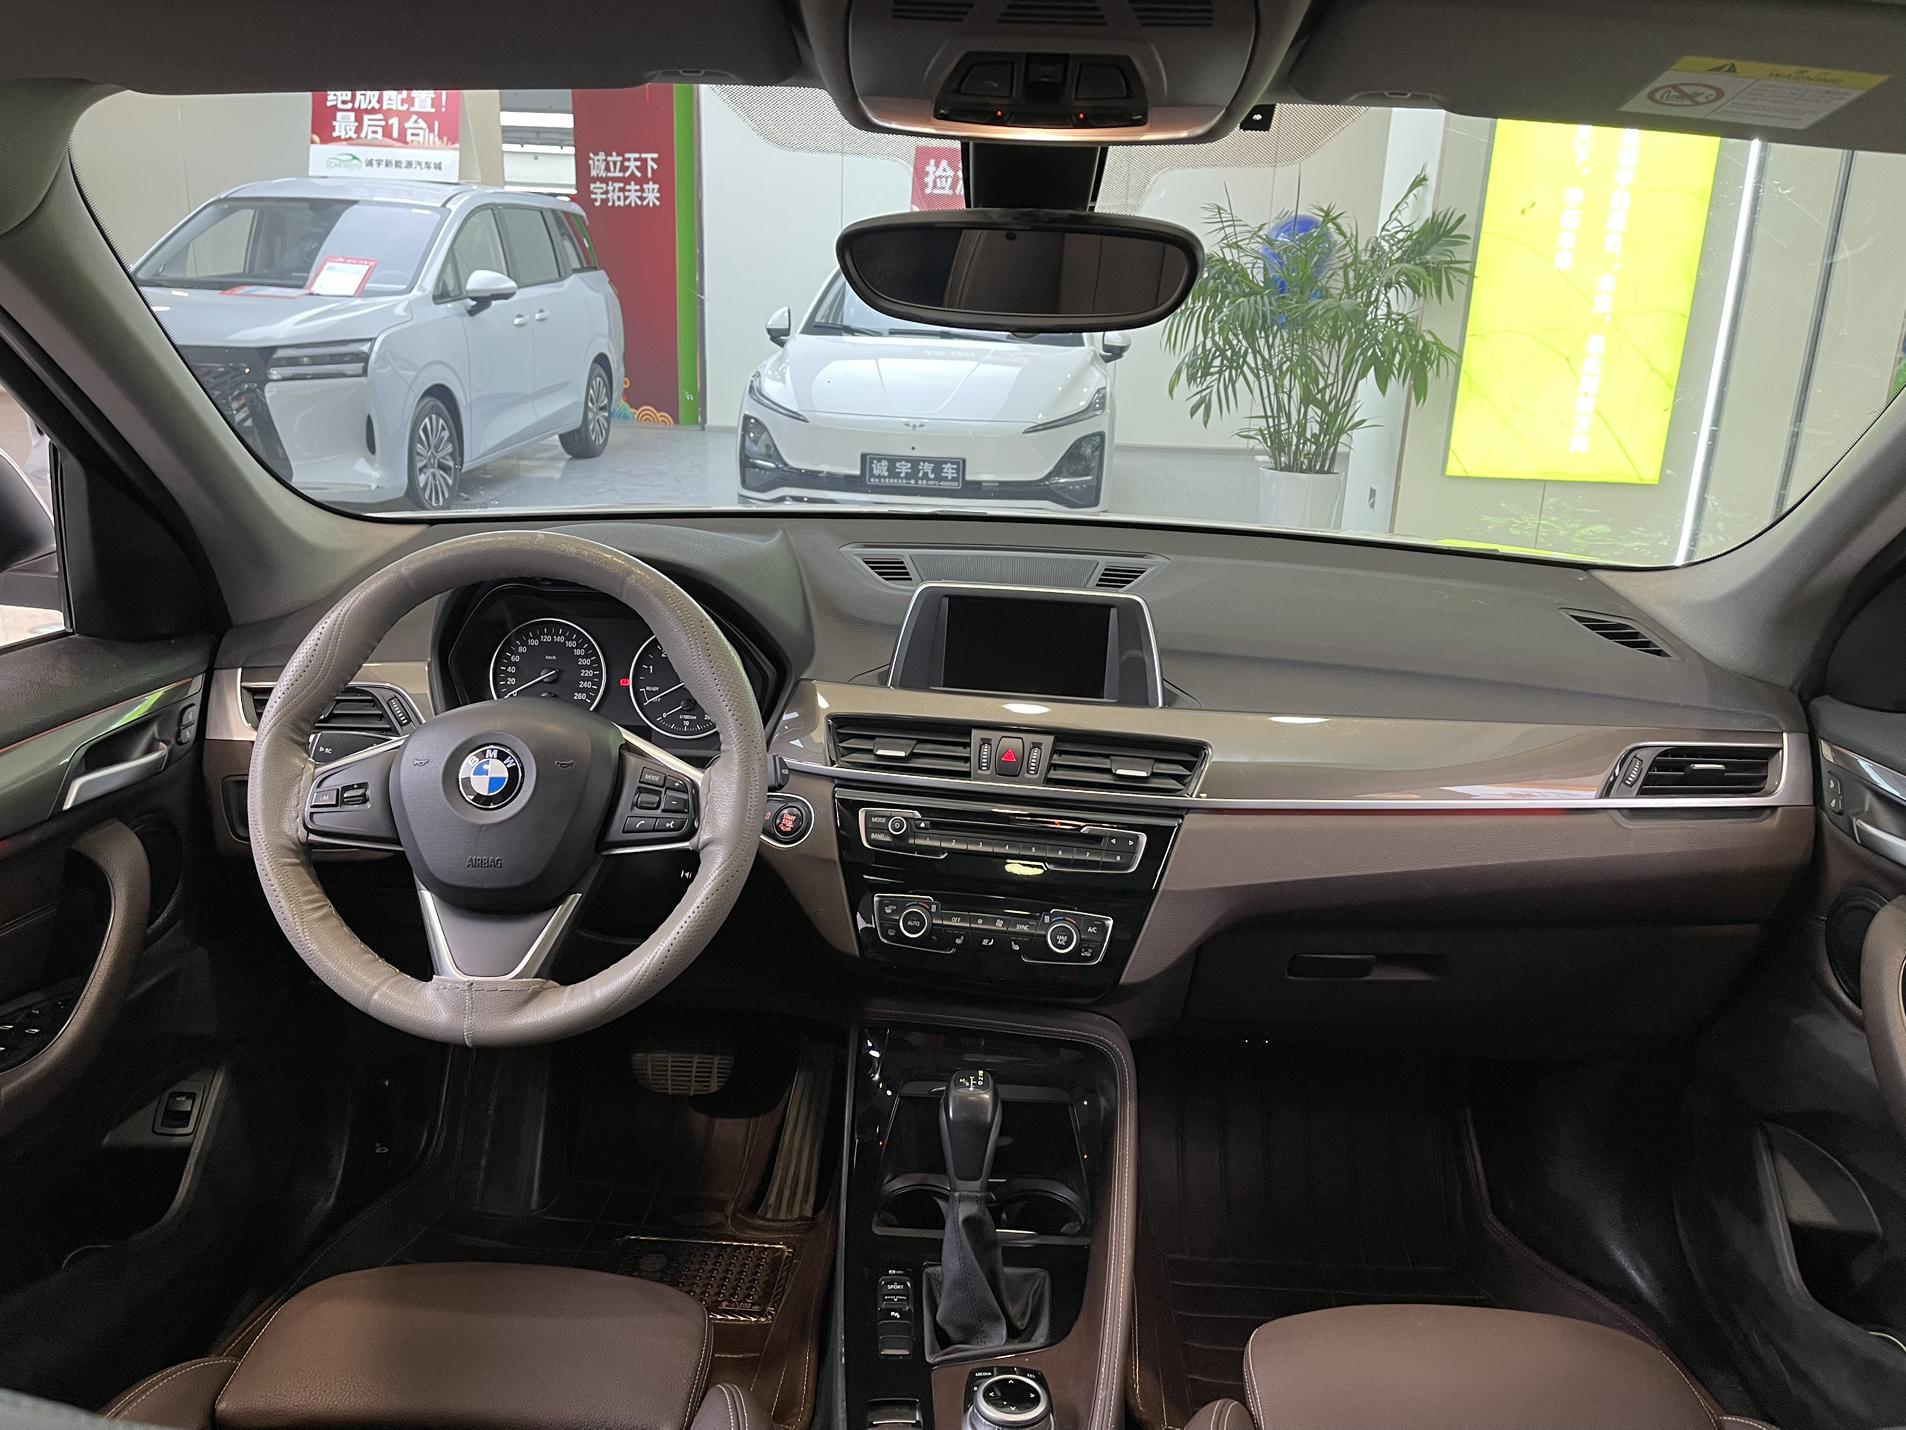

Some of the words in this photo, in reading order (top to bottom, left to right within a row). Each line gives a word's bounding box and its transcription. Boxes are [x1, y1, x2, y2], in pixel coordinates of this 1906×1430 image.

[588, 151, 659, 178] 诚立天下
[589, 181, 661, 207] 宇拓未来
[871, 459, 958, 479] 诚宇汽车
[574, 648, 585, 656] 180
[510, 654, 520, 662] 60
[506, 666, 516, 674] 40
[506, 677, 516, 685] 20
[573, 692, 587, 700] 260
[467, 748, 517, 769] BMW
[871, 816, 886, 824] MODE
[466, 857, 503, 869] AIRBAG
[907, 919, 920, 927] AUTO
[951, 916, 961, 924] OFF
[1016, 923, 1029, 931] SYNC
